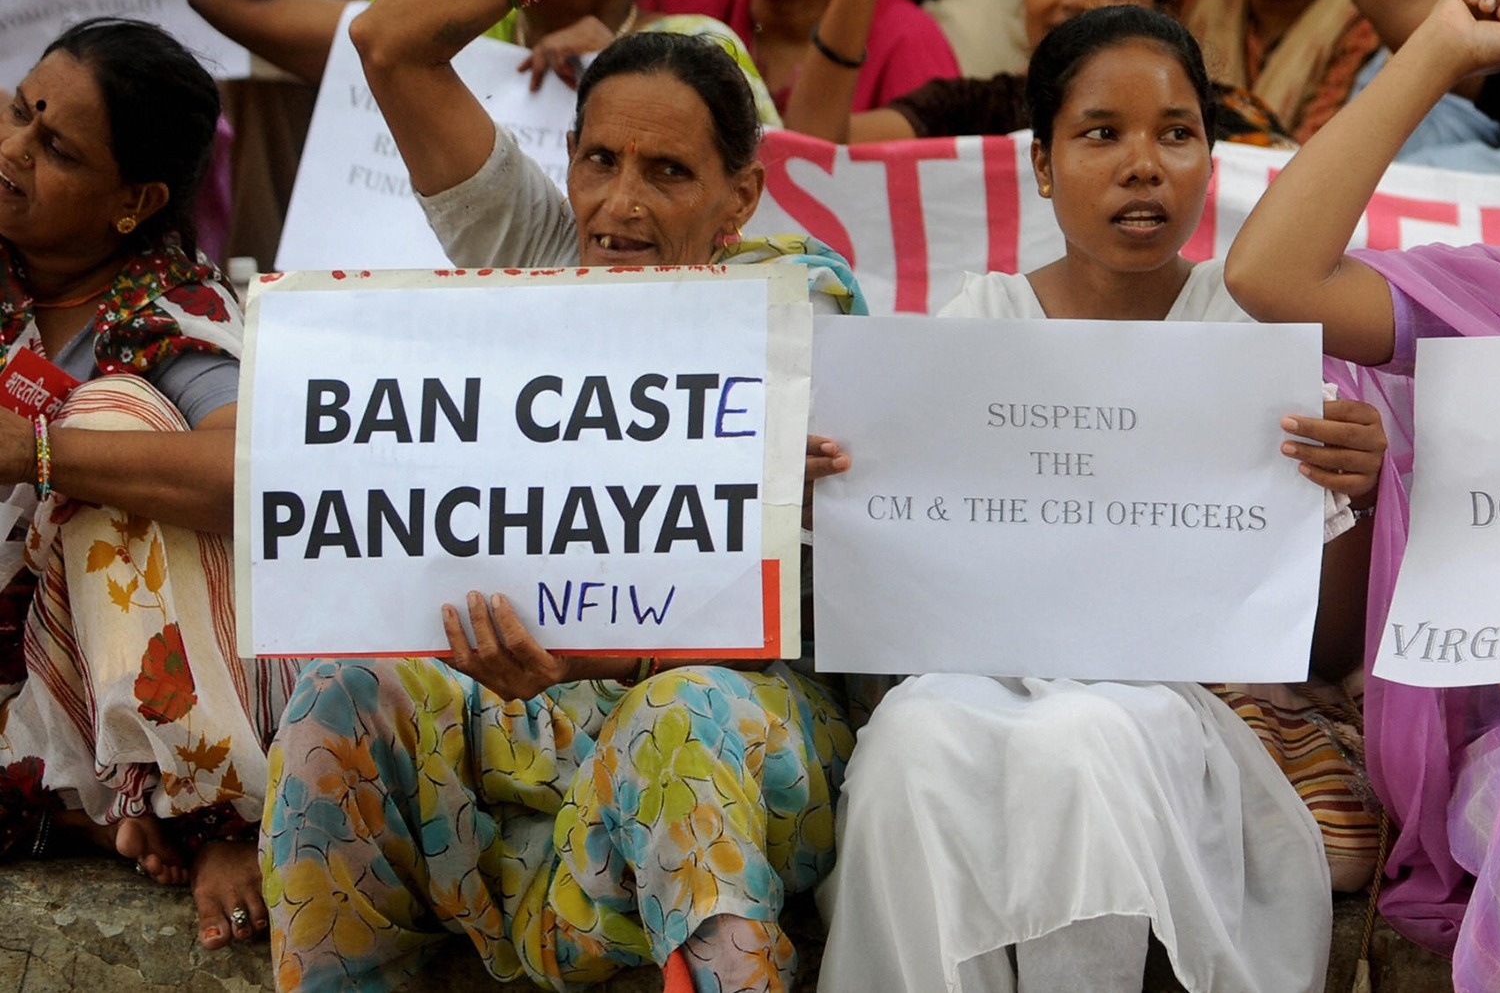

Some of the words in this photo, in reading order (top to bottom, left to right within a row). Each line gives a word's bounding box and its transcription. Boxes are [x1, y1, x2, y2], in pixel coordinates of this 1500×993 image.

[5, 371, 51, 411] भारतीय
[304, 377, 481, 445] BAN
[515, 373, 763, 442] CASTE
[986, 402, 1138, 432] SUSPEND
[1030, 451, 1095, 477] THE
[262, 483, 758, 560] PANCHAYAT
[867, 495, 914, 521] CM
[927, 496, 950, 522] &
[964, 496, 1028, 524] THE
[1040, 499, 1095, 526] CBI
[1105, 500, 1268, 533] OFFICERS
[537, 579, 675, 626] NFIW
